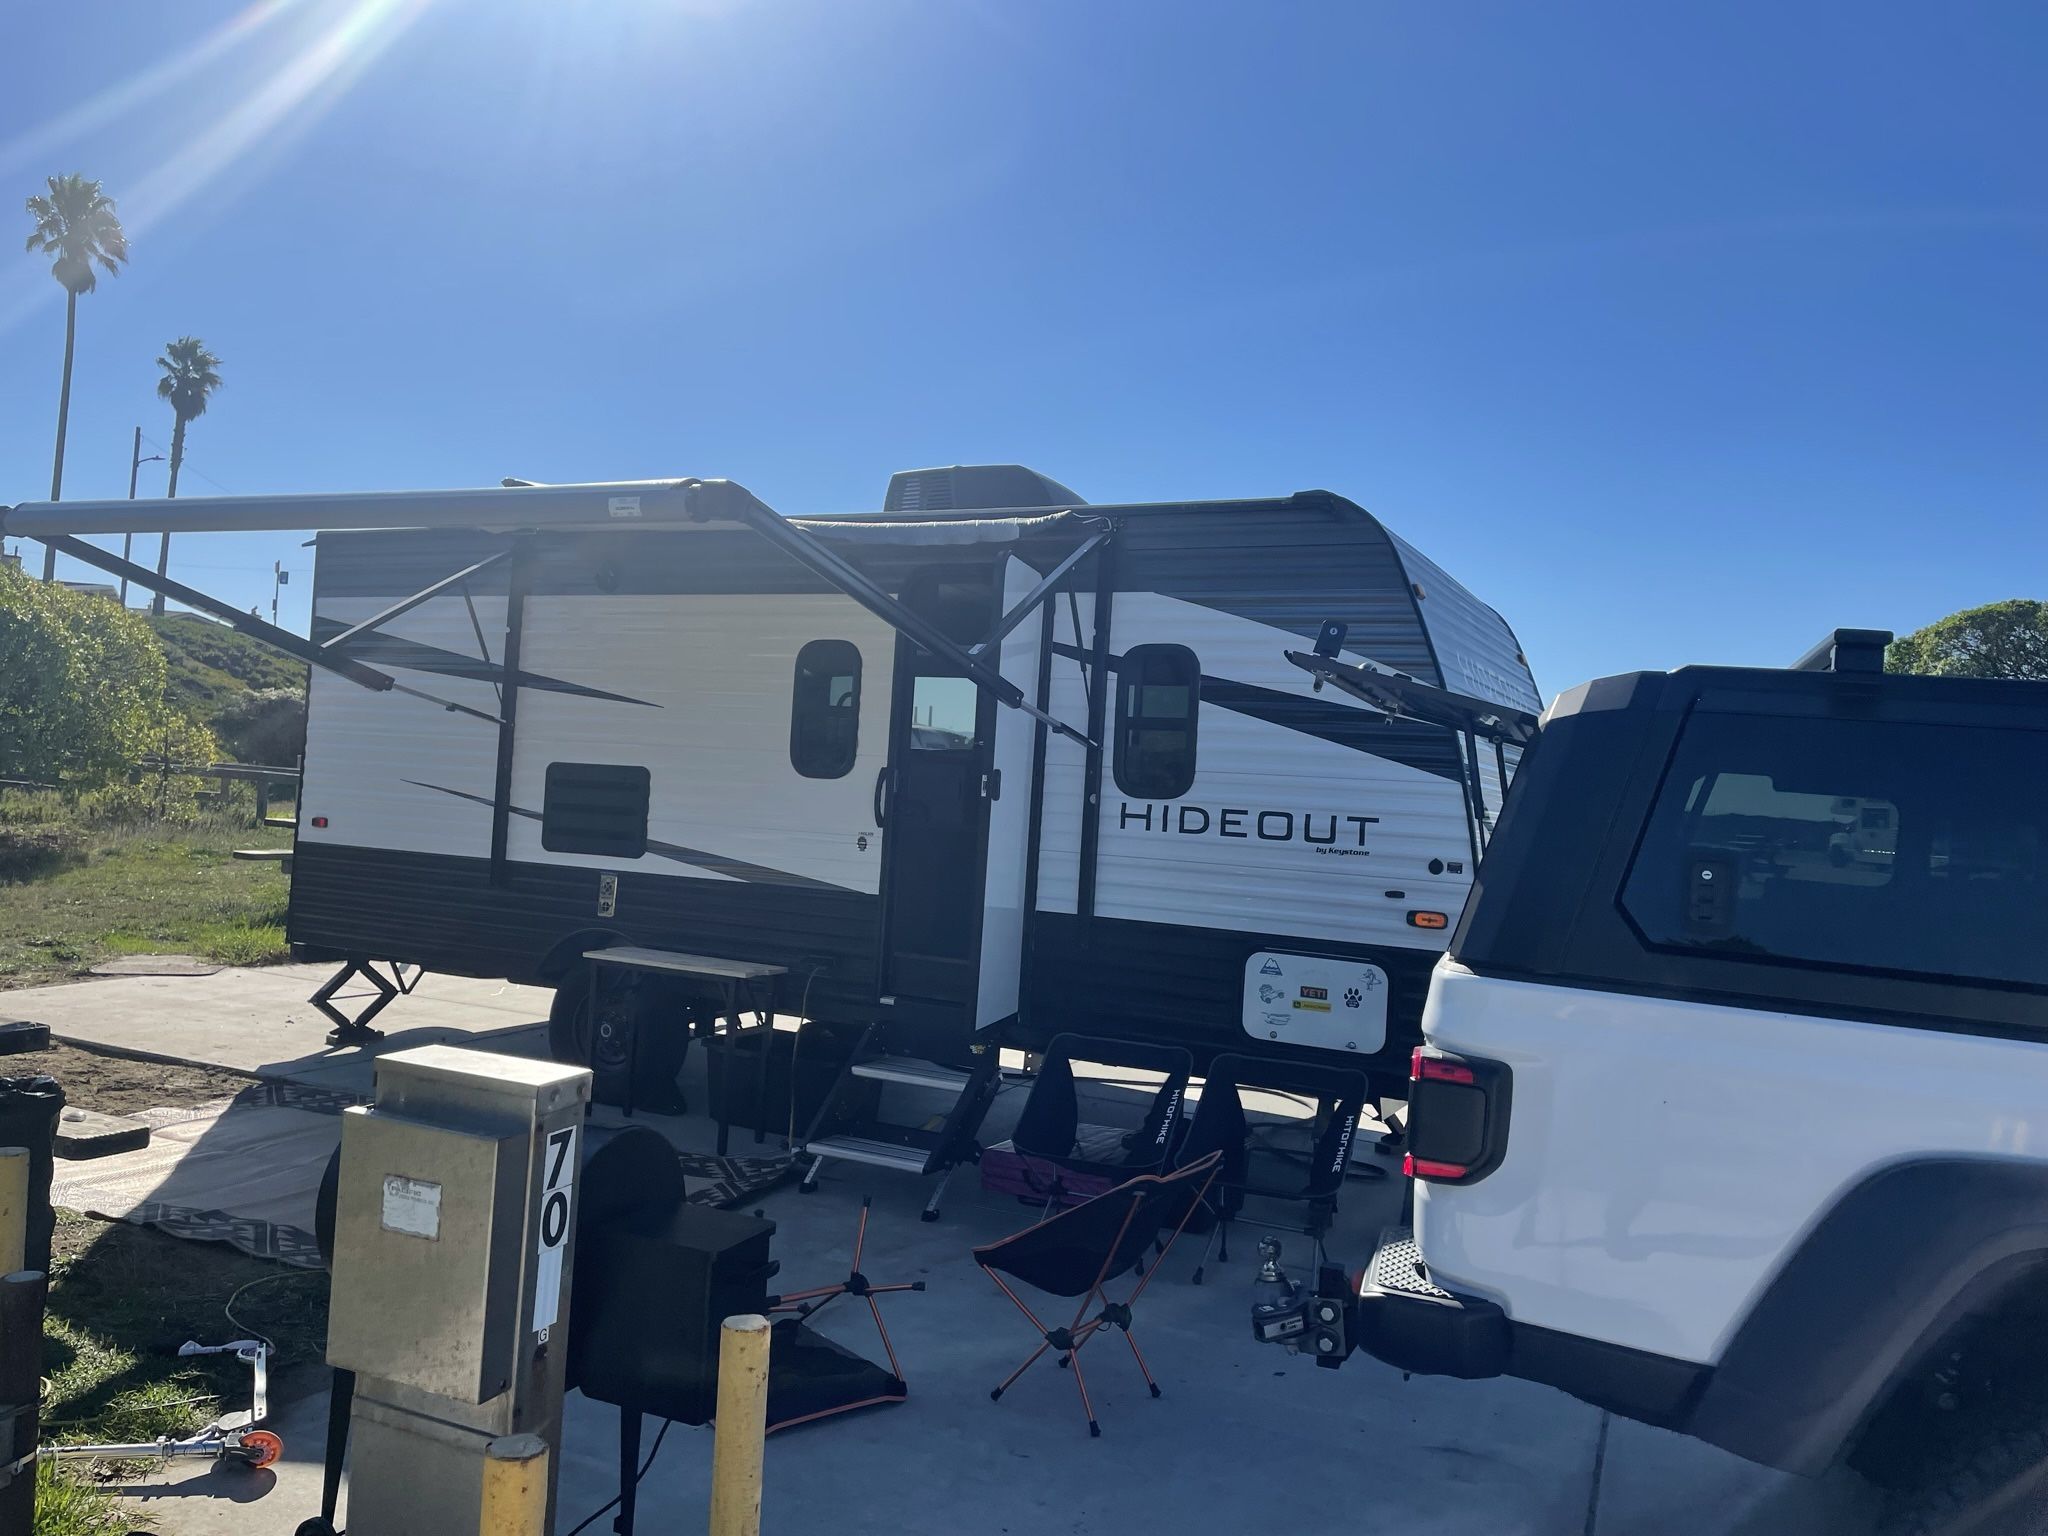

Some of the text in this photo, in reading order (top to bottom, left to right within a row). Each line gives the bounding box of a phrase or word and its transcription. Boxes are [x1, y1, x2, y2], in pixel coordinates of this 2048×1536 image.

[1119, 802, 1380, 847] HIDEOUT
[1316, 847, 1370, 857] by Keystone
[1302, 987, 1326, 999] YETI
[542, 1129, 573, 1247] 70
[539, 1327, 548, 1342] G
